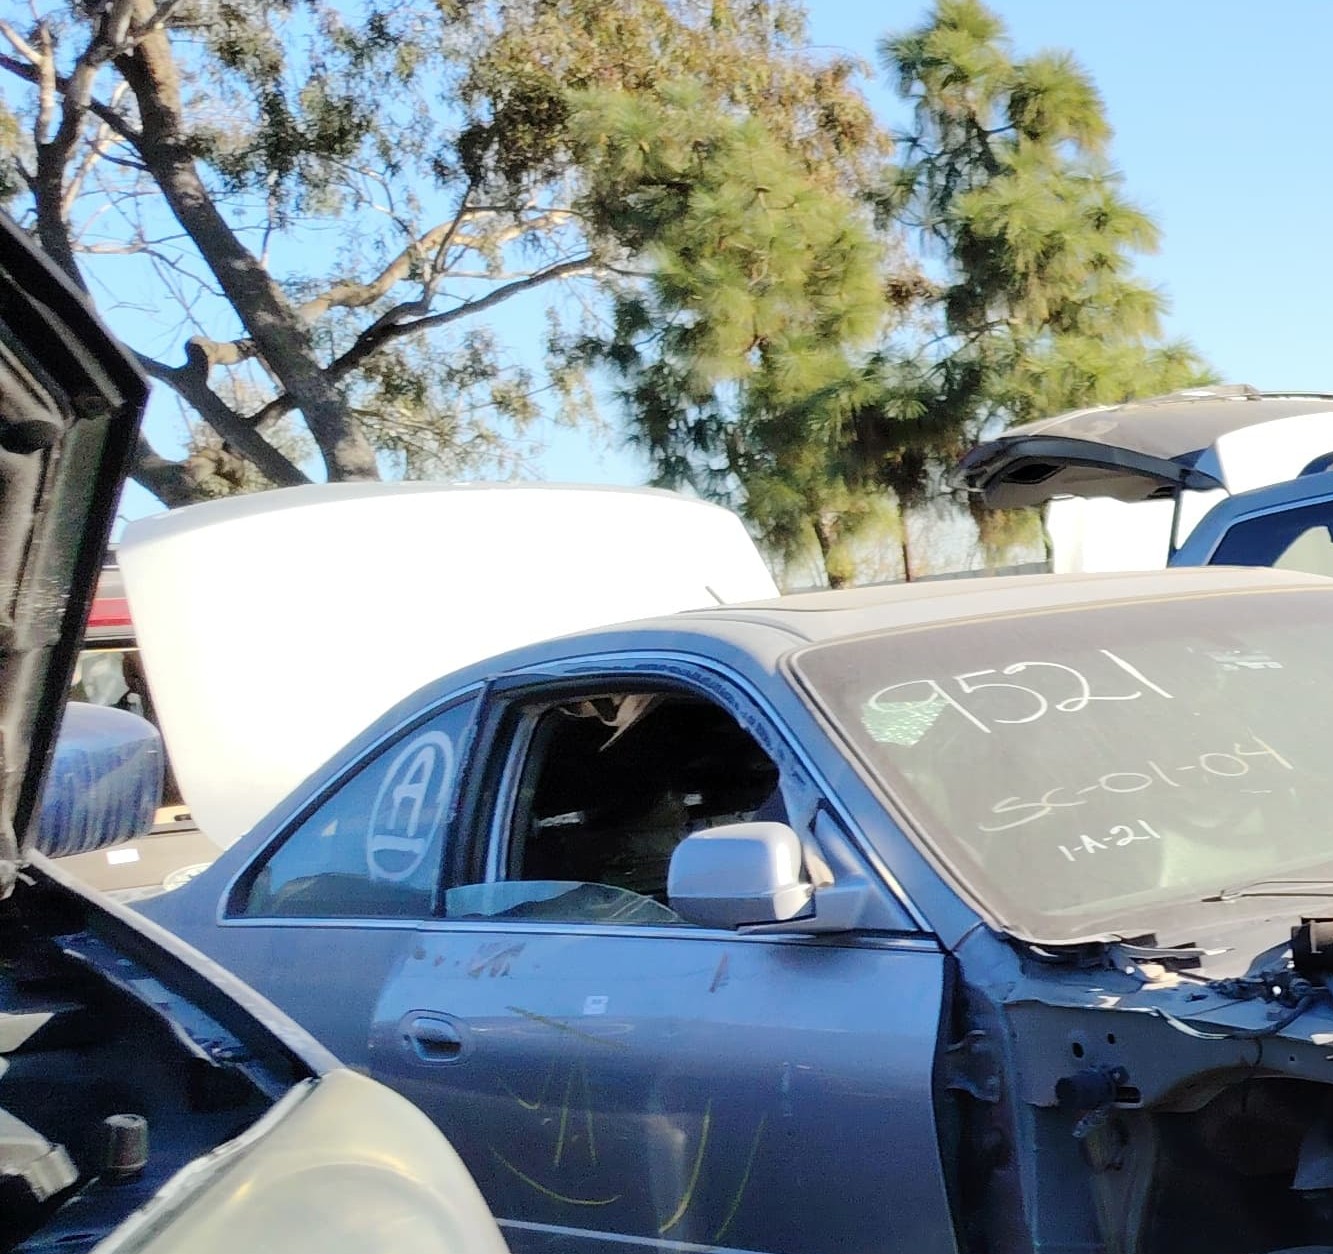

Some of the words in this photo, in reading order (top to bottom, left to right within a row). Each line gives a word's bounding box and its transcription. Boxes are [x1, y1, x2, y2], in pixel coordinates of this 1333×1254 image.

[867, 649, 1174, 734] 9521
[977, 731, 1294, 832] SC-01-04
[1057, 819, 1161, 862] 1-A-21
